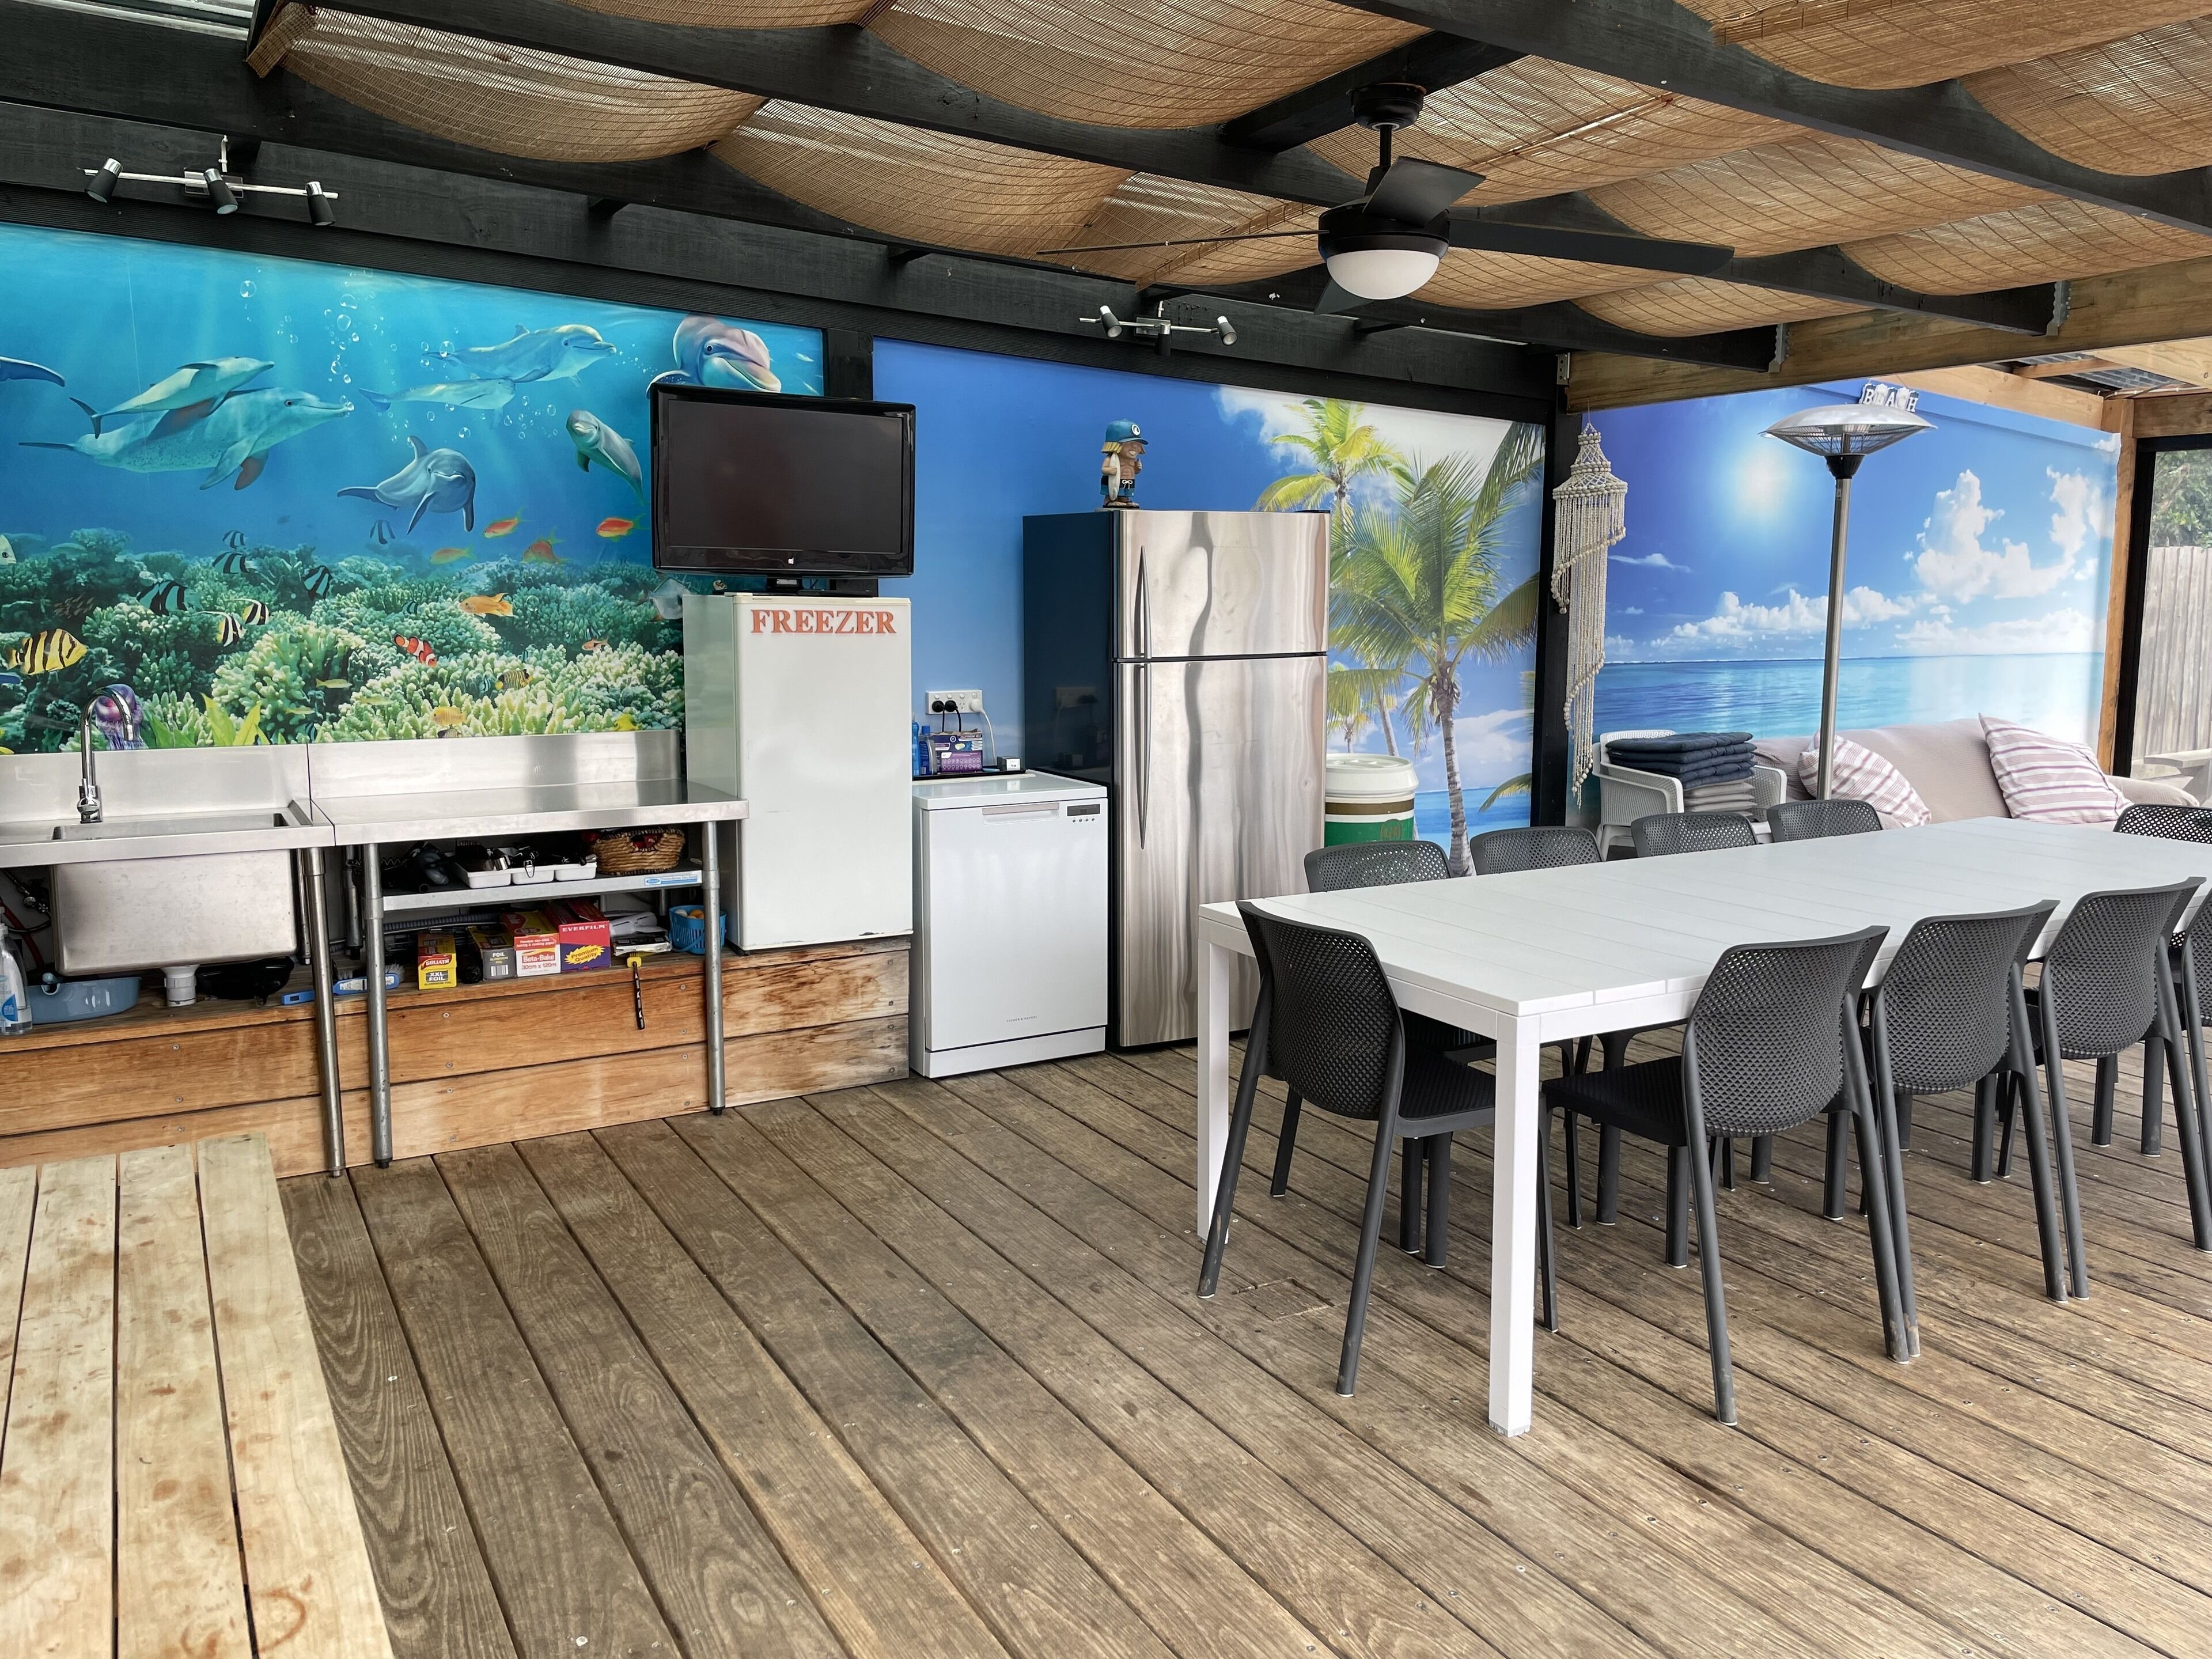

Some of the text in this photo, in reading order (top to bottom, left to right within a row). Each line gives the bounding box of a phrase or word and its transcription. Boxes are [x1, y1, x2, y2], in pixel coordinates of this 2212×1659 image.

[1862, 387, 1919, 413] BEACH
[751, 609, 896, 634] FREEZER
[562, 924, 605, 932] EVERFILM
[523, 954, 555, 963] Beta-Bake
[571, 946, 599, 959] Premium
[575, 952, 597, 963] Quality
